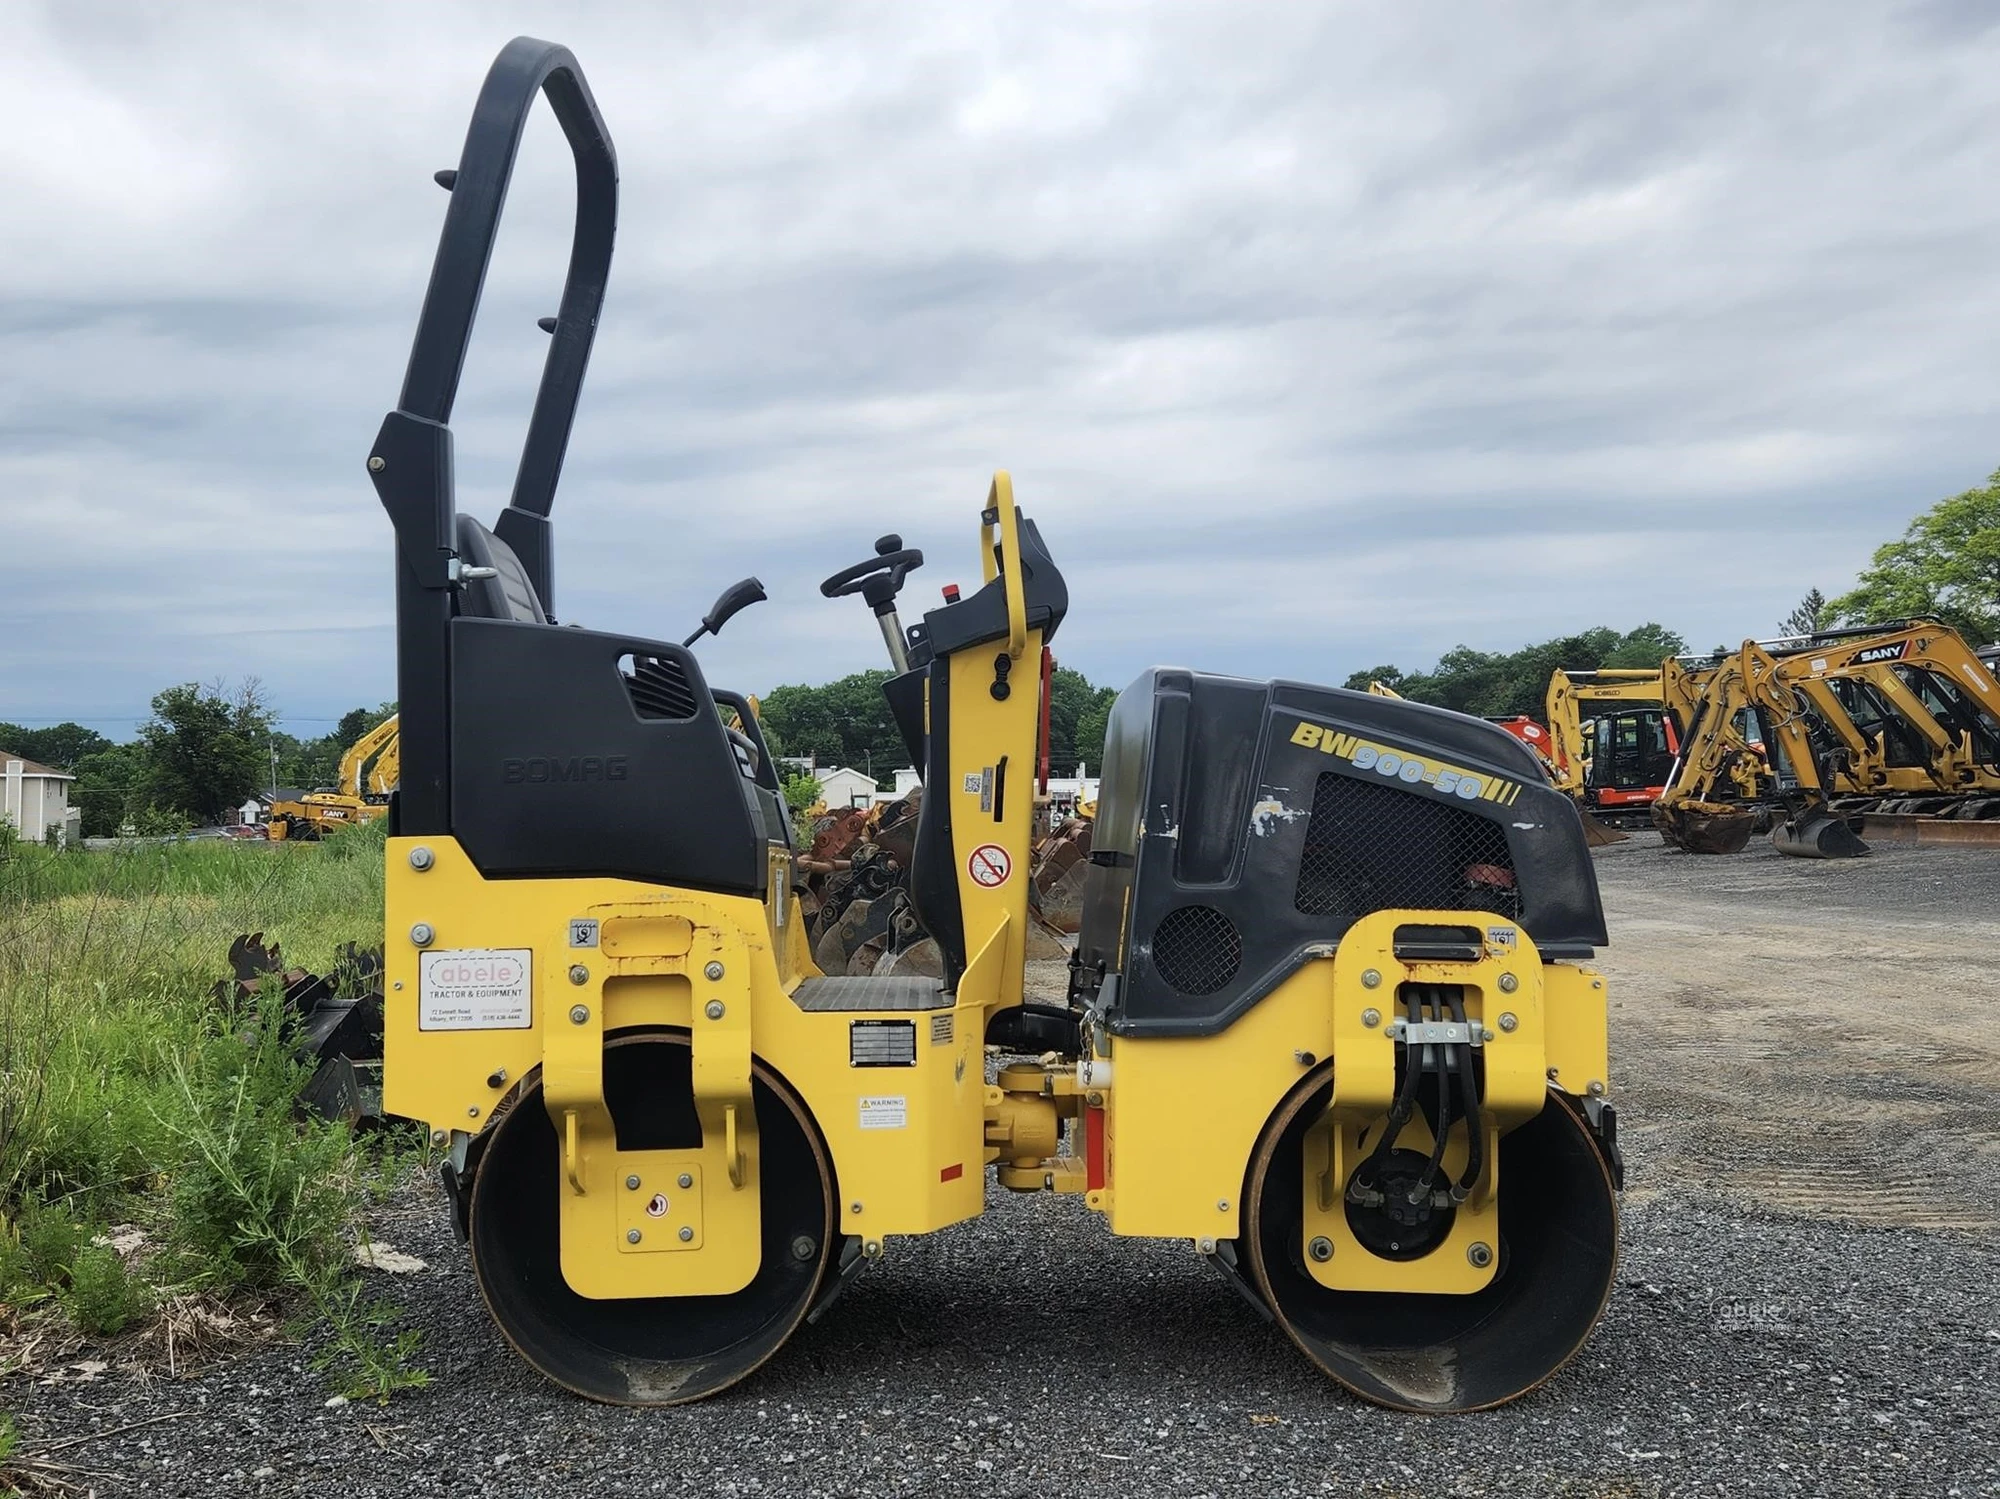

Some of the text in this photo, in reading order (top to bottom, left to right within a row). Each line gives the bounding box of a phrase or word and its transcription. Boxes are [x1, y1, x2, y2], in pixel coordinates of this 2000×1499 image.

[1860, 646, 1901, 662] SANY
[502, 754, 628, 784] BOMAG
[441, 963, 511, 983] abele
[430, 990, 466, 999] TRACTOR
[476, 989, 522, 998] EQUIPMENT
